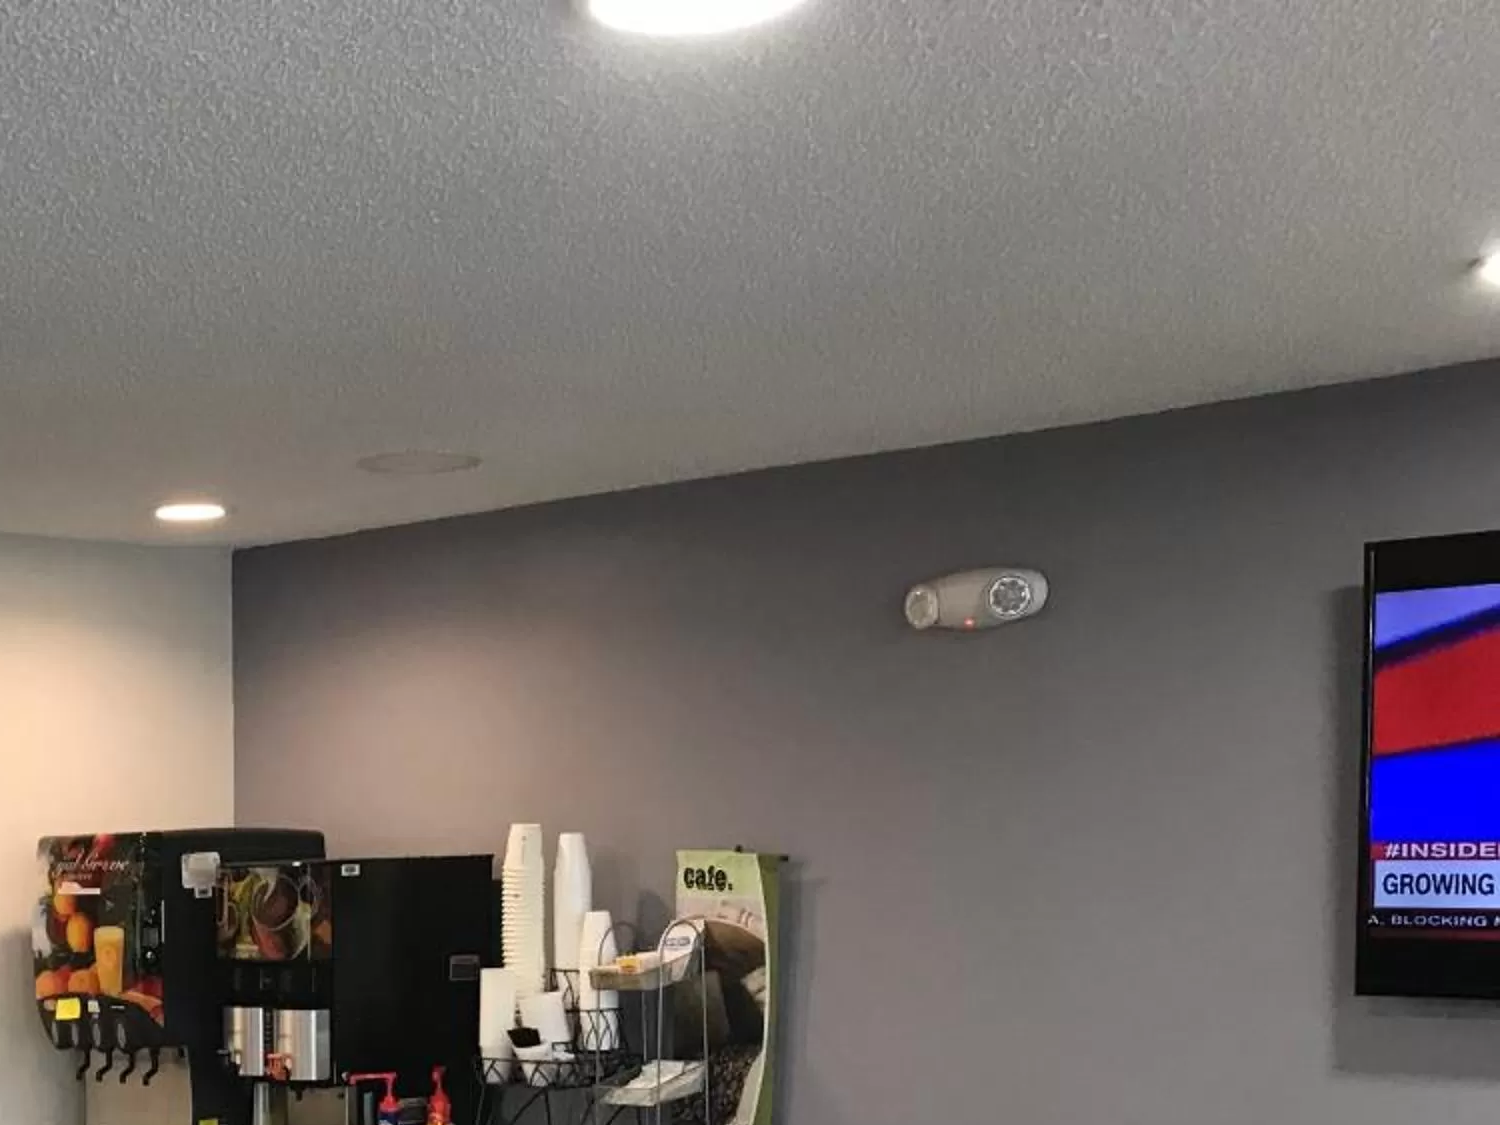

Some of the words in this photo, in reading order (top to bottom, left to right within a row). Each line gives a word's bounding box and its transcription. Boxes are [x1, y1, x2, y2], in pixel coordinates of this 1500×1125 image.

[1384, 842, 1500, 858] #INSIDE
[1383, 873, 1495, 896] GROWING
[1391, 915, 1487, 927] BLOCKING
